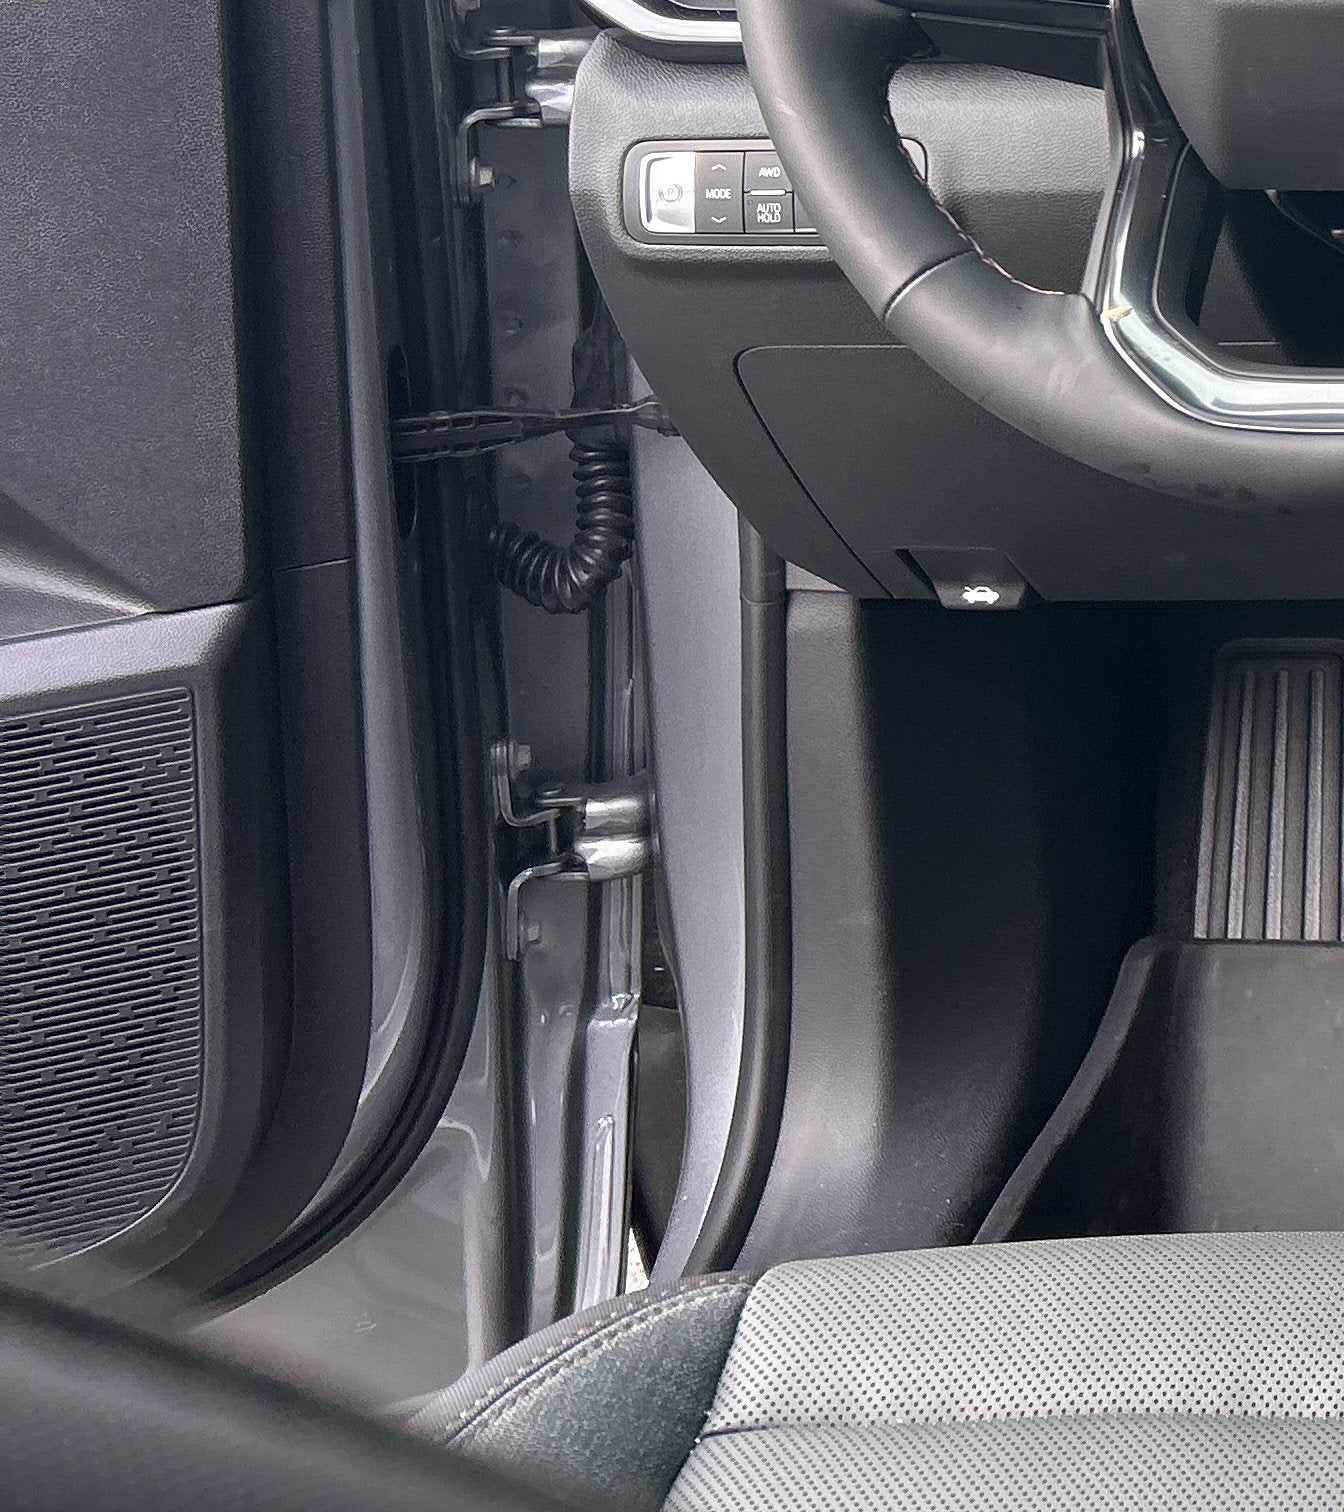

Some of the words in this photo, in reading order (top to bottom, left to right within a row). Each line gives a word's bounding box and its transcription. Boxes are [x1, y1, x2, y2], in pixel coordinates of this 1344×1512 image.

[758, 167, 781, 178] AWD
[705, 188, 732, 199] MODE
[756, 202, 781, 213] AUTO
[757, 213, 781, 223] HOLD
